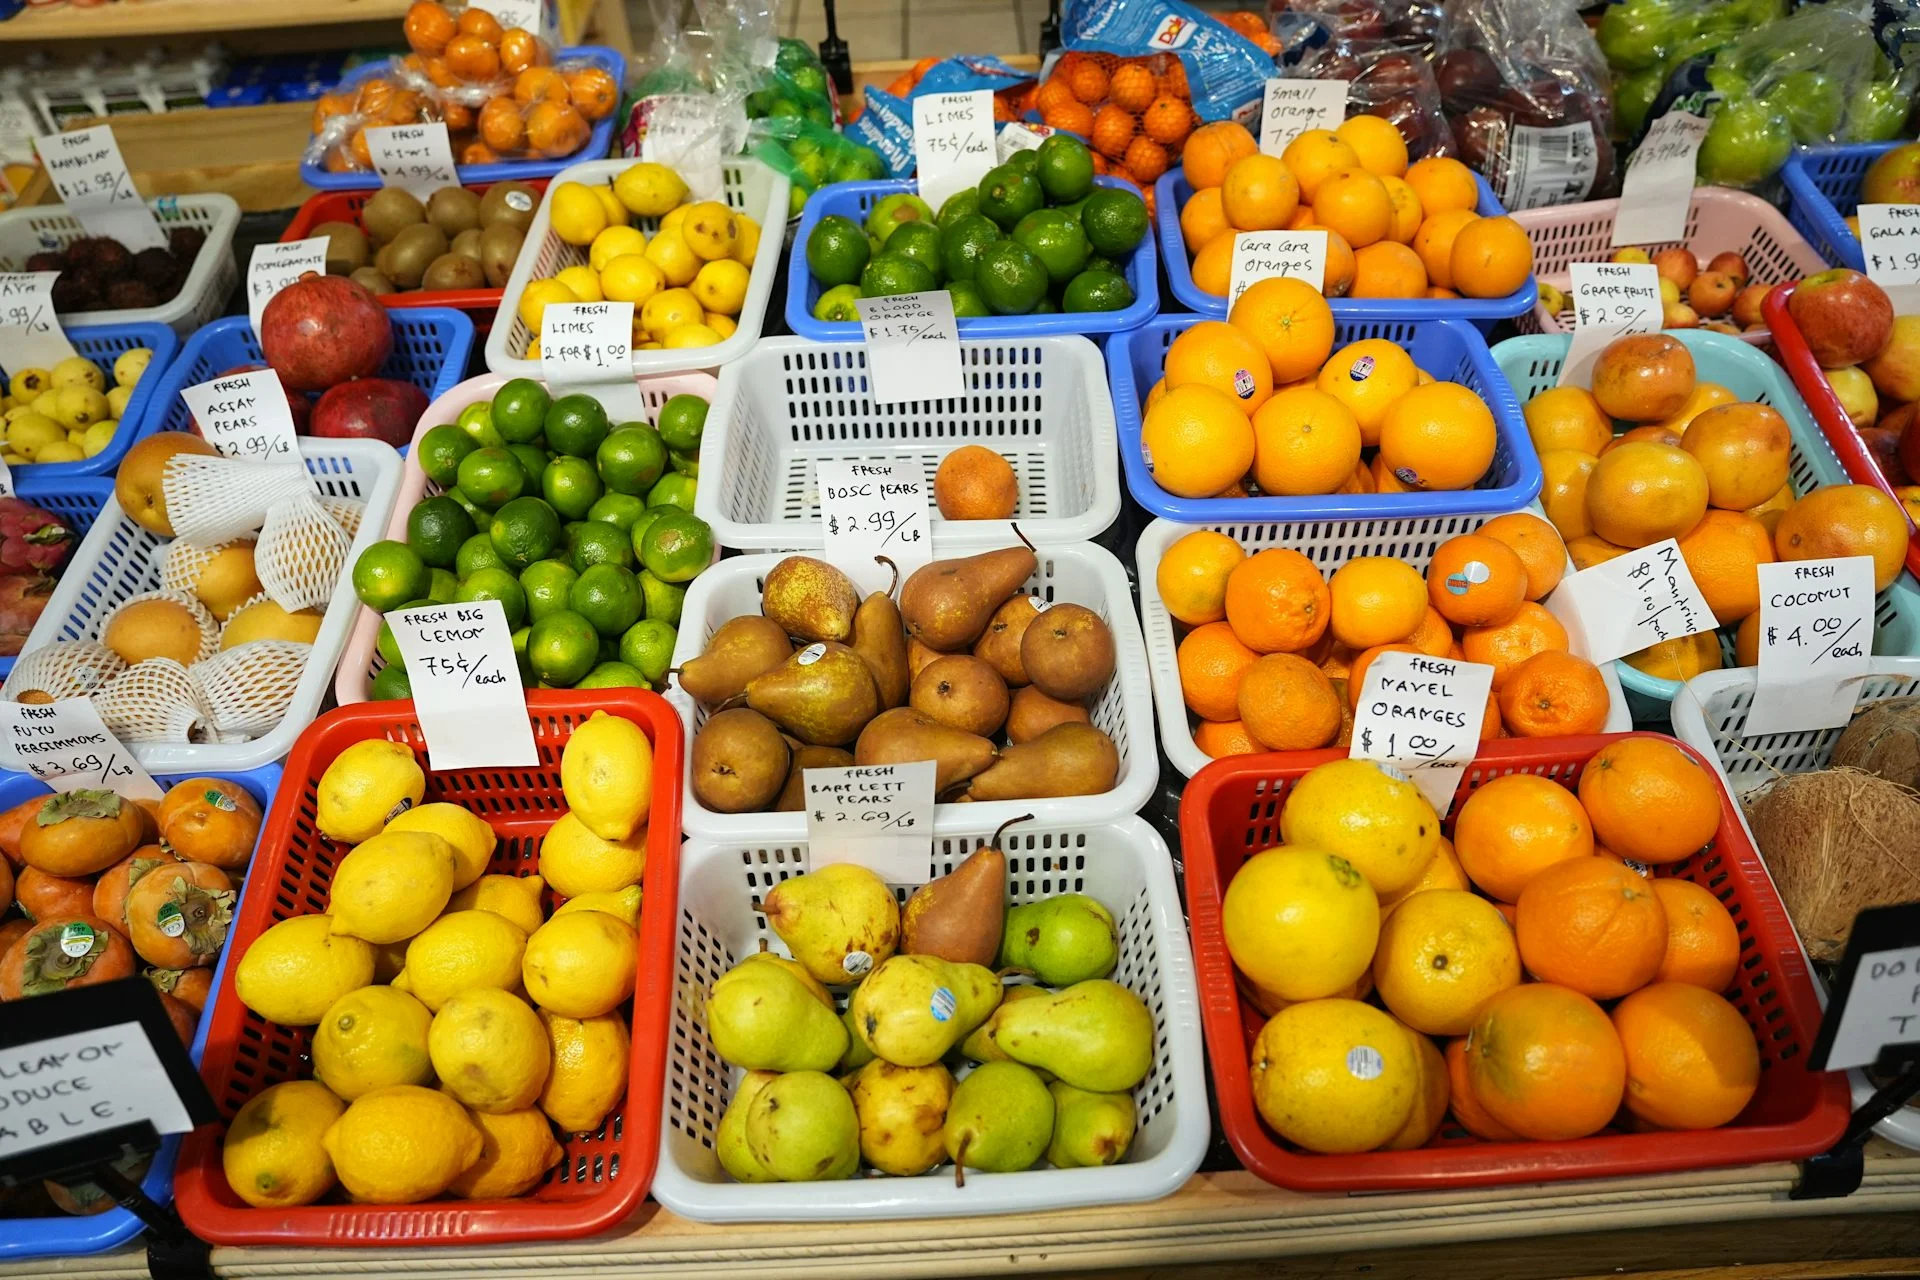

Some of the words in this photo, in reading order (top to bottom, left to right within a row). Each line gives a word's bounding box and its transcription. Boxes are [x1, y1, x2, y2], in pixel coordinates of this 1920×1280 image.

[924, 107, 974, 126] LIMES
[1870, 226, 1905, 240] GALA
[1597, 266, 1631, 278] FRESH
[573, 305, 609, 316] FRESH
[552, 321, 595, 335] LIMES
[545, 346, 555, 361] 2
[214, 378, 252, 394] FRESH
[207, 397, 256, 415] ASIAN
[214, 415, 257, 435] PEARS
[851, 465, 892, 476] FRESH
[828, 483, 872, 500] BOSC
[880, 483, 919, 501] PEARS
[1795, 566, 1835, 580] FRESH
[1770, 587, 1850, 608] COCONUT
[404, 611, 448, 626] FRESH
[457, 608, 484, 622] BIG
[420, 627, 485, 643] LEMON
[1409, 657, 1457, 677] FRESH
[1381, 677, 1454, 697] NAVEL
[20, 707, 57, 720] FRESH
[1371, 702, 1467, 728] ORANGES
[13, 724, 55, 738] FUYU
[14, 733, 107, 756] PERSIMMONS
[844, 766, 895, 779] FRESH
[836, 794, 895, 805] PEARS
